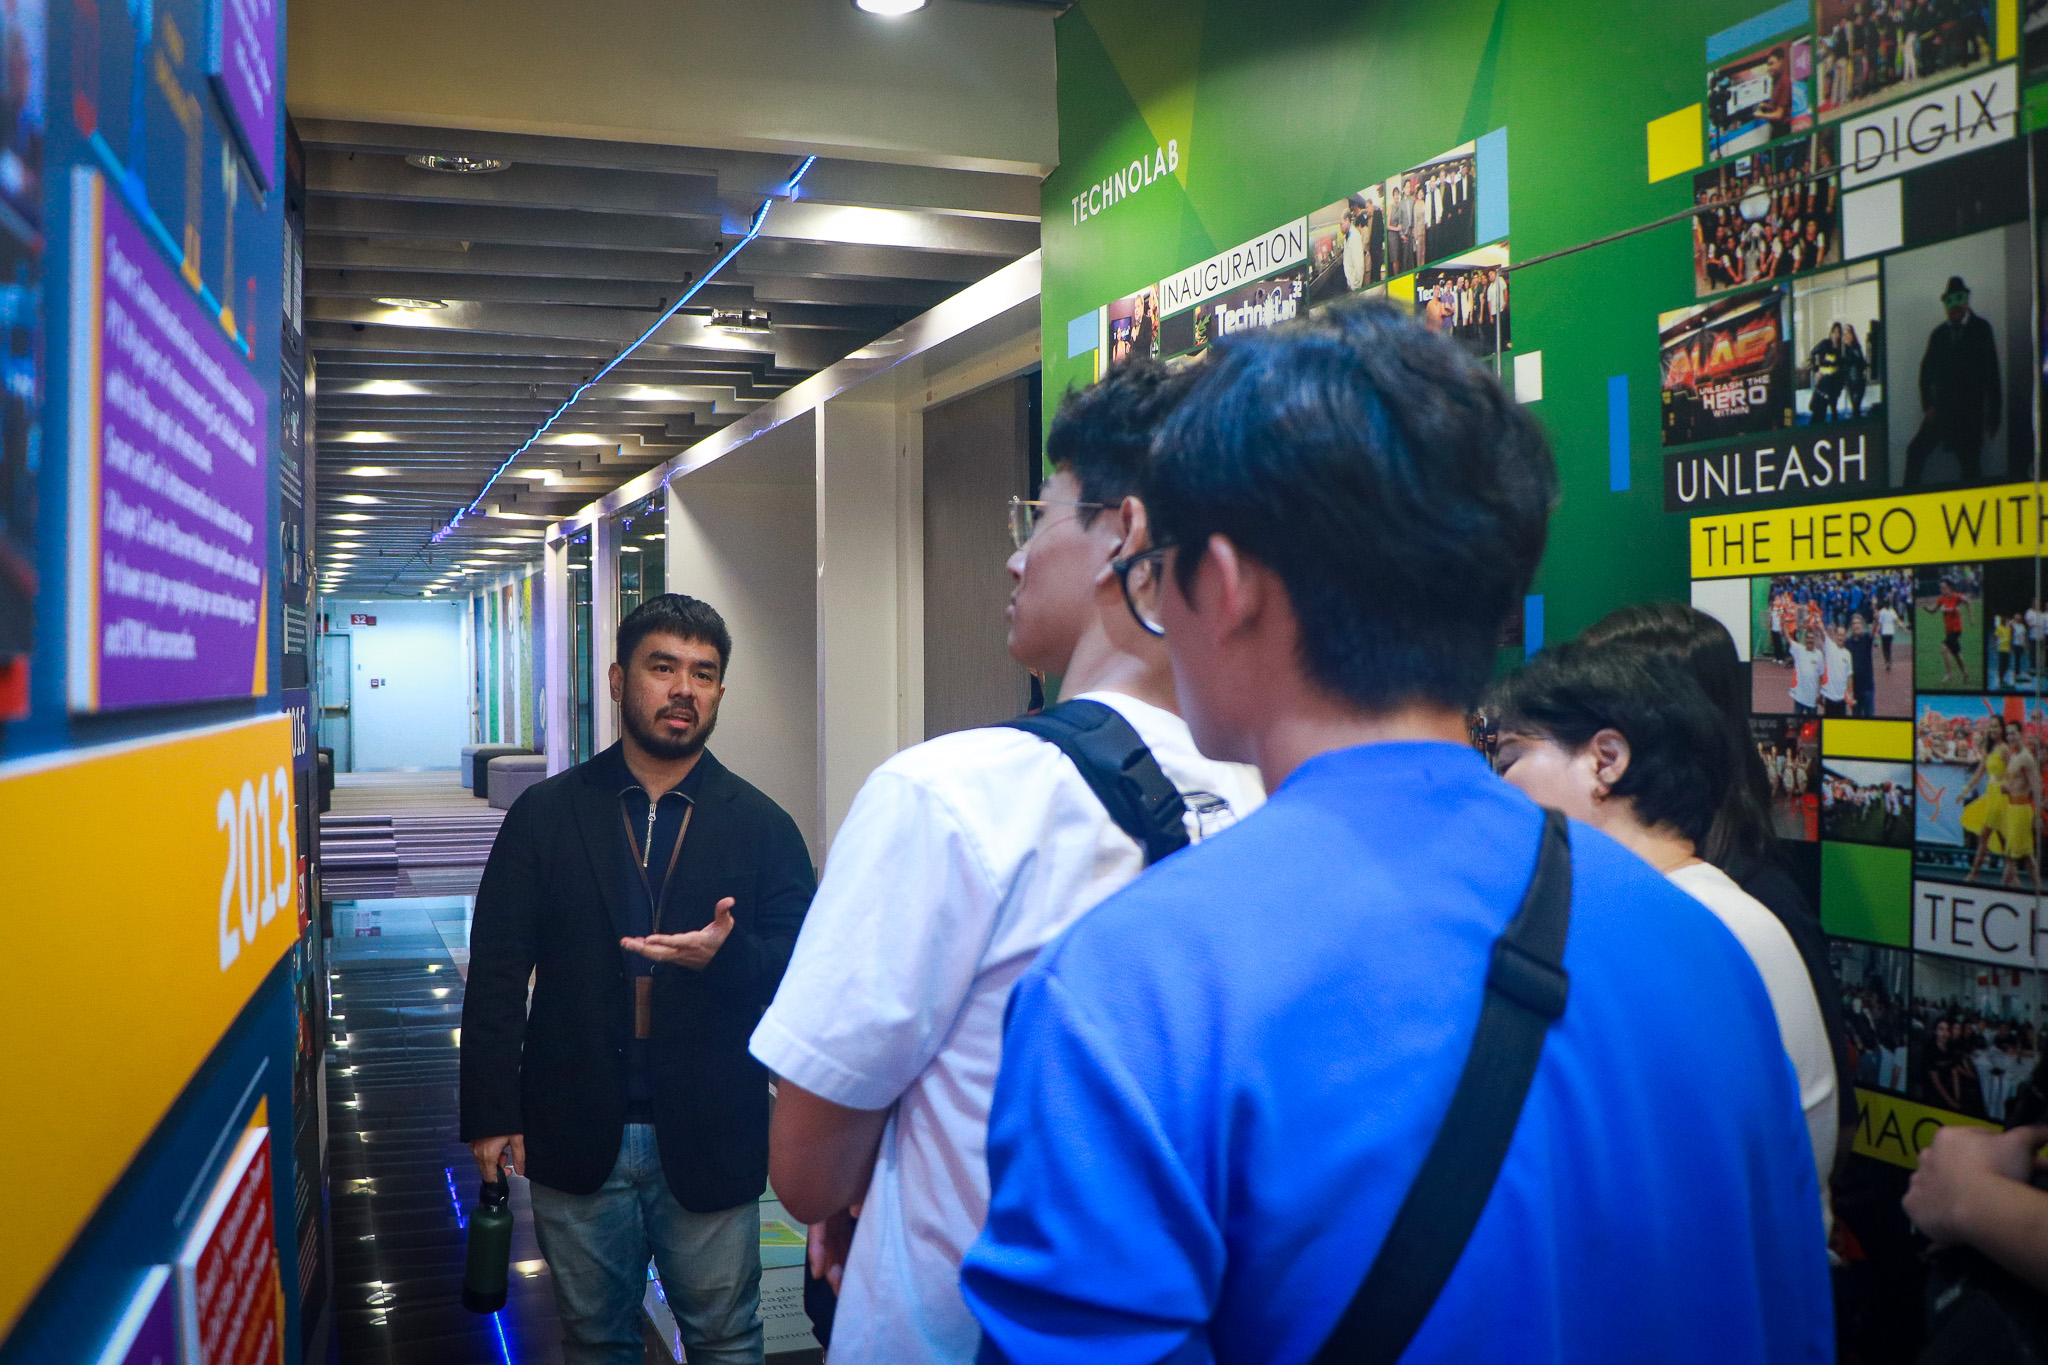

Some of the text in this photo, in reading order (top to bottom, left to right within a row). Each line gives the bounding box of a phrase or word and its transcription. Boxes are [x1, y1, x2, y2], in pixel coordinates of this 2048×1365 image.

[1854, 82, 1998, 174] DIGIX
[1071, 139, 1180, 226] TECHNOLAB
[1162, 224, 1303, 310] INAUGURATION
[1703, 385, 1768, 410] HERO
[1746, 374, 1770, 387] THE
[1712, 405, 1750, 418] WITHIN
[1676, 434, 1867, 503] UNLEASH
[1702, 521, 1771, 567] THE
[1790, 507, 1917, 561] HERO
[353, 615, 367, 624] 32
[286, 705, 306, 758] 016
[217, 766, 292, 973] 2013
